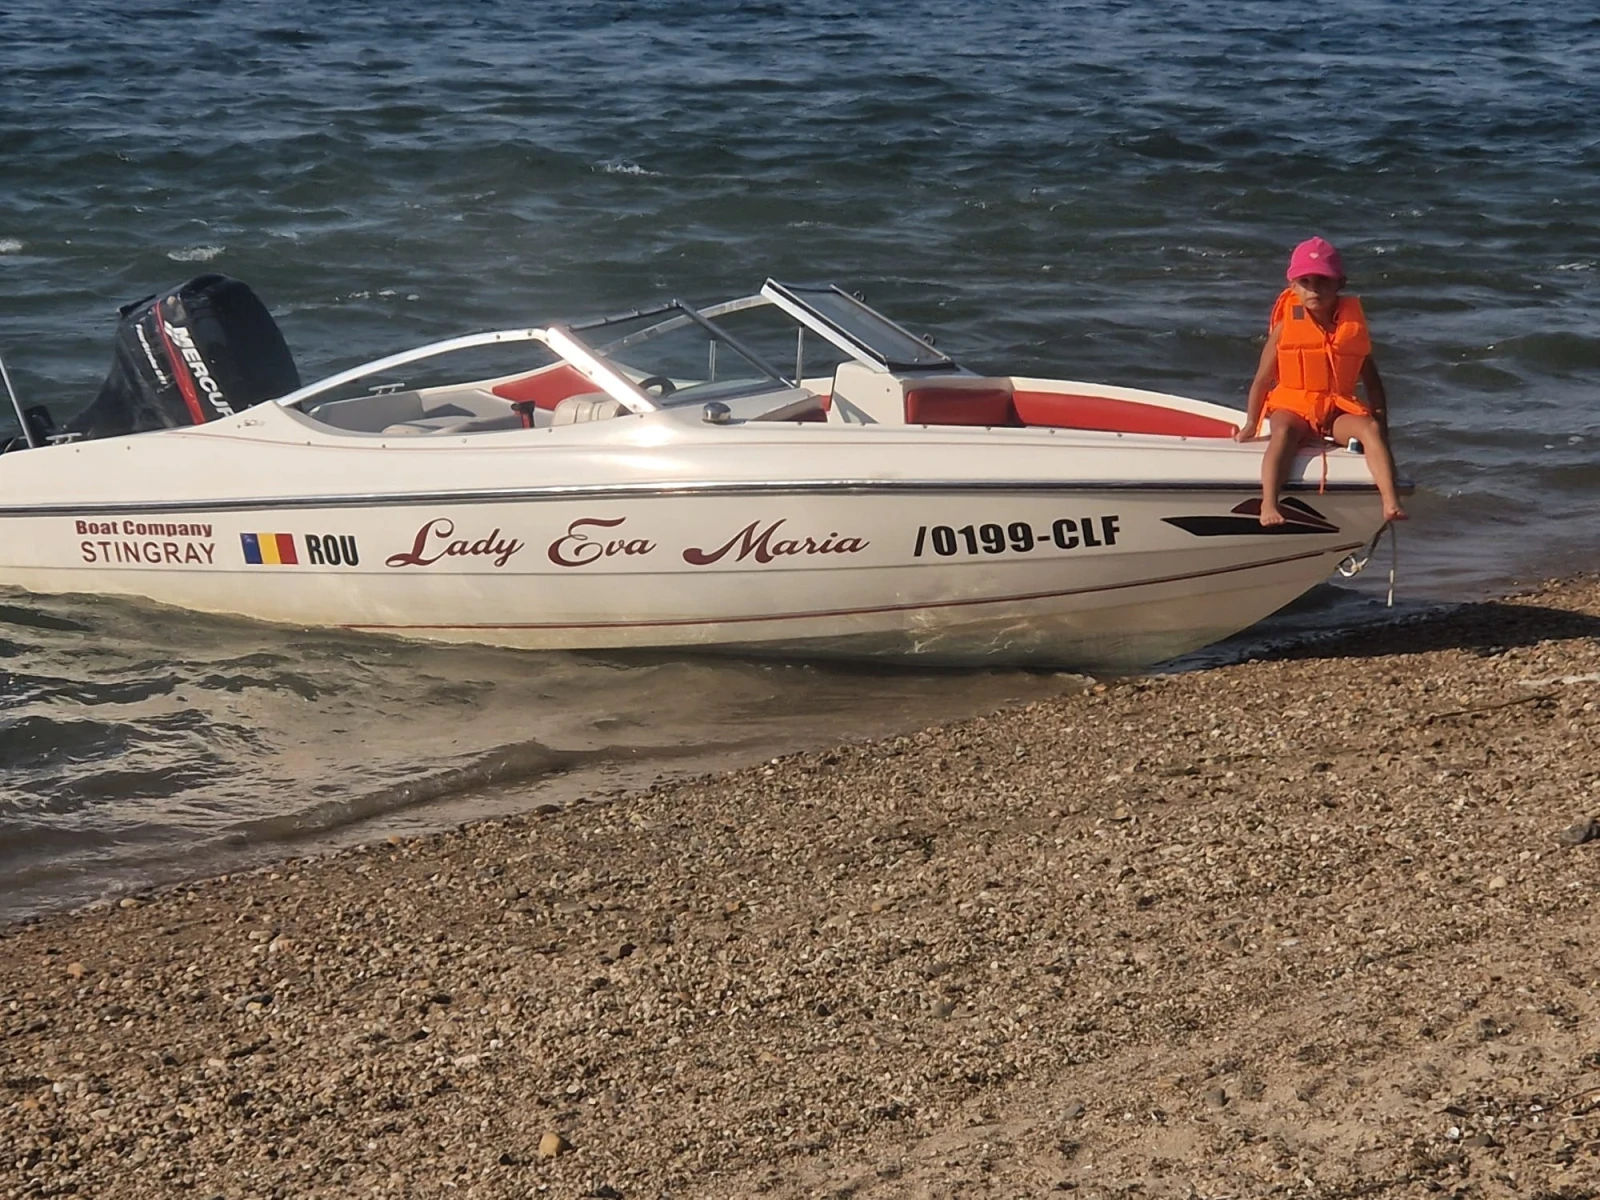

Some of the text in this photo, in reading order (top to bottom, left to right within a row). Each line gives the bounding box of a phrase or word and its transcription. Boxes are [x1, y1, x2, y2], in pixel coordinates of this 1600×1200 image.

[164, 321, 236, 418] MERCUR
[75, 519, 212, 538] Boat Company
[385, 516, 870, 567] Lady Eva Maria
[913, 515, 1120, 557] /0199-CLF
[81, 541, 216, 564] STINGRAY
[304, 533, 359, 566] ROU
